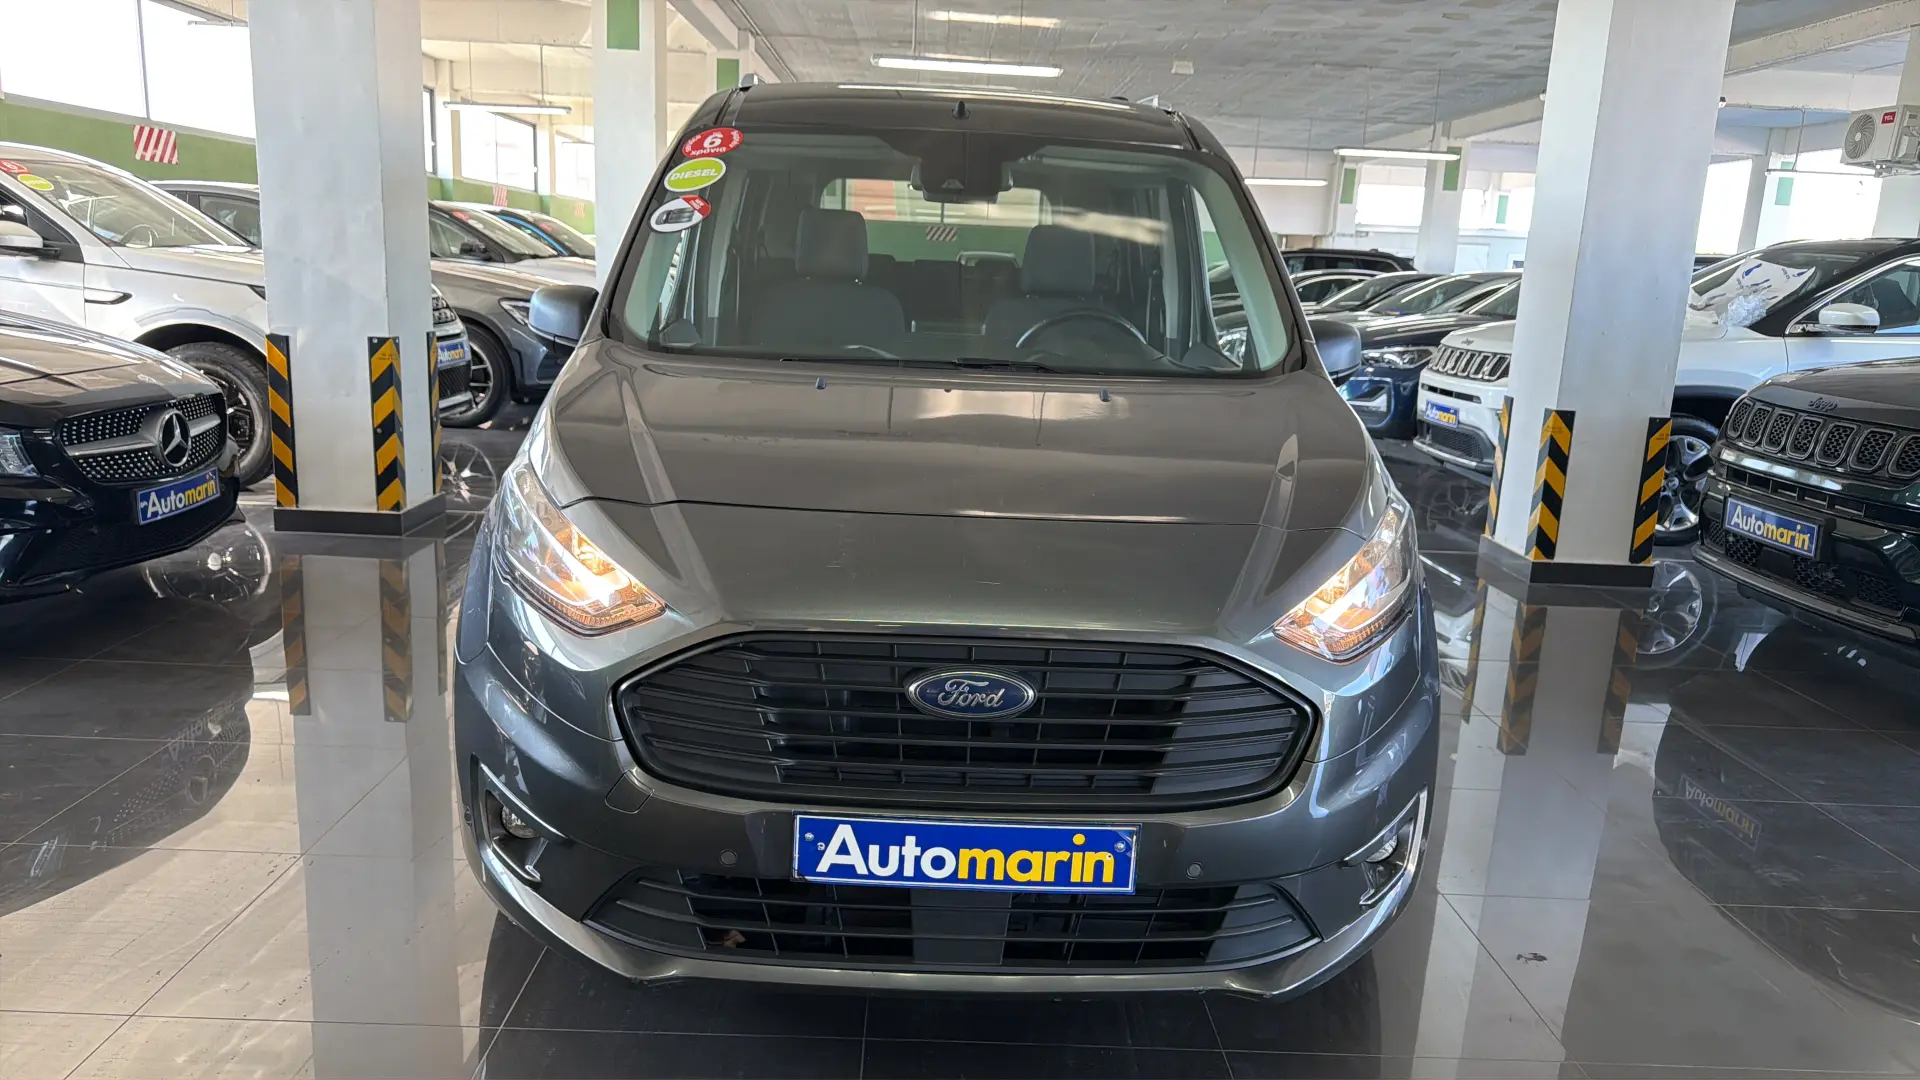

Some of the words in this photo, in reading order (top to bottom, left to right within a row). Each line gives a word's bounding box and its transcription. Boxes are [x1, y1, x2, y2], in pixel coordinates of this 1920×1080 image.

[703, 134, 723, 148] 6
[670, 168, 718, 180] DIESEL
[146, 474, 217, 518] Automarin
[1731, 505, 1811, 550] Automarin
[938, 678, 1005, 708] Ford
[815, 823, 1115, 884] Automarin
